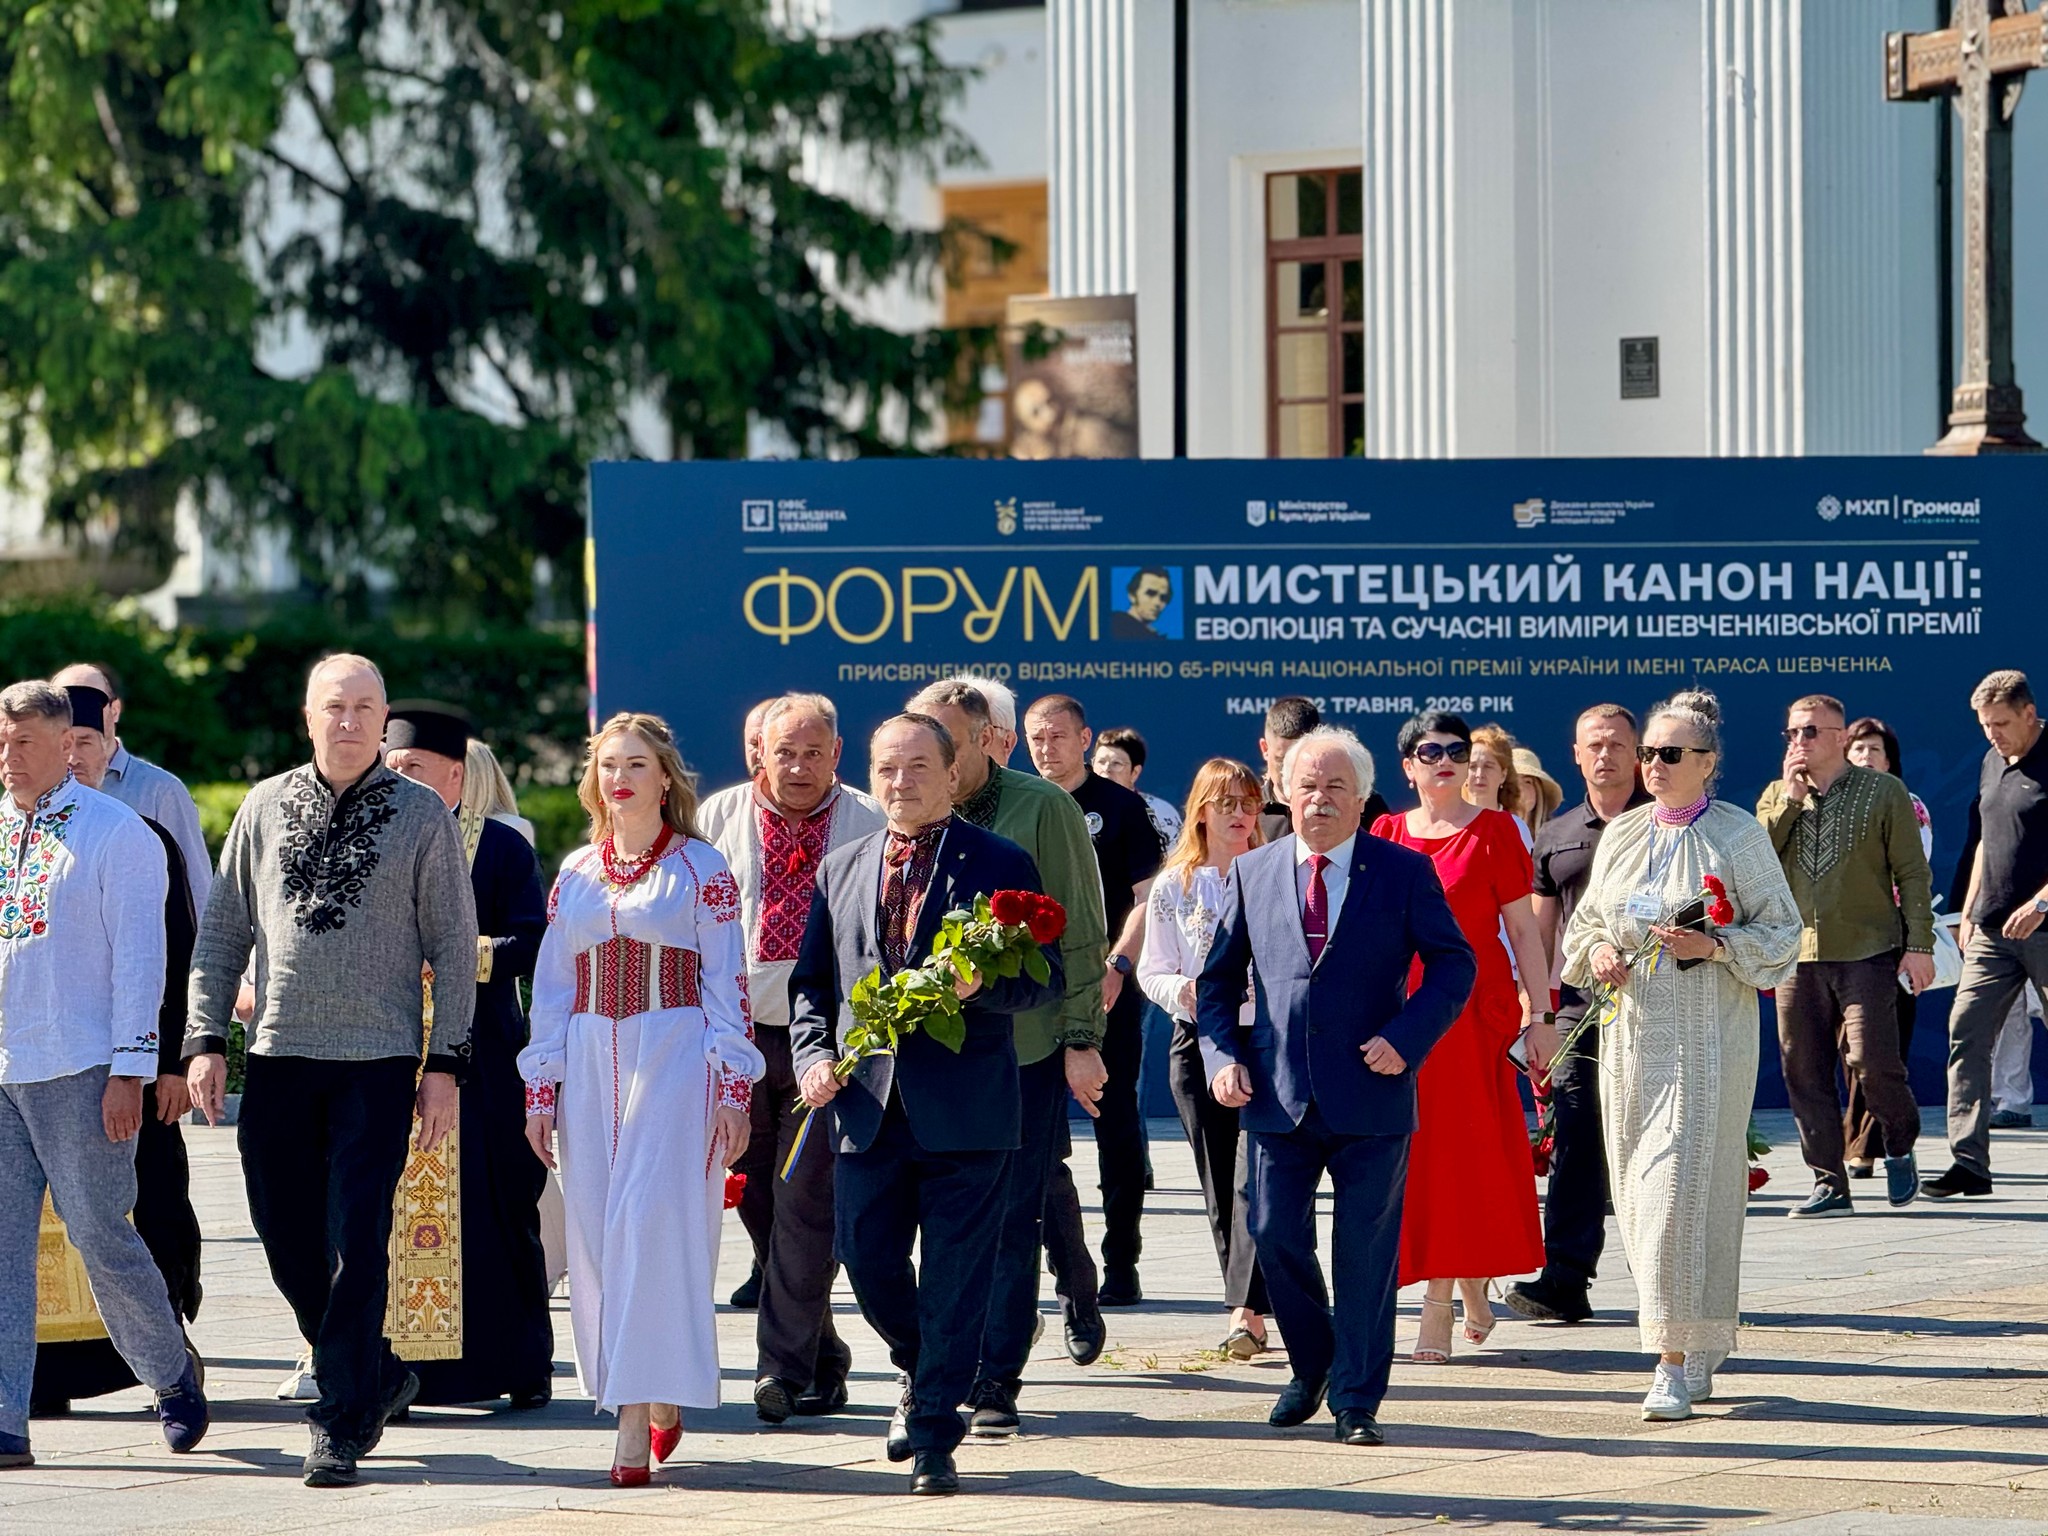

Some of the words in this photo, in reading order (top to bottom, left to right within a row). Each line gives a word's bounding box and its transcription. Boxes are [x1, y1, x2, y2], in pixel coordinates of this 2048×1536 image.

[1845, 499, 1890, 516] МХП
[1902, 498, 1981, 518] Громаді
[1194, 554, 1581, 611] МИСТЕЦЬКИЙ
[1603, 562, 1792, 602] КАНОН
[1815, 551, 1982, 606] НАЦІЇ:
[743, 567, 1099, 645] ФОРУМ
[1195, 616, 1344, 643] ЕВОЛЮЦІЯ
[1350, 617, 1386, 640] ТА
[1391, 616, 1511, 640] СУЧАСНІ
[1519, 615, 1628, 638] ВИМІРИ
[1636, 608, 1880, 637] ШЕВЧЕНКІВСЬКОЇ
[1887, 607, 1982, 635] ПРЕМІЇ
[838, 663, 1012, 681] ПРИСВЯЧЕНОГО
[1018, 662, 1173, 681] ВІДЗНАЧЕННЮ
[1179, 660, 1274, 679] 65-РІЧЧЯ
[1281, 657, 1443, 679] НАЦІОНАЛЬНОЇ
[1451, 656, 1522, 676] ПРЕМІЇ
[1529, 656, 1619, 676] УКРАЇНИ
[1627, 658, 1685, 675] ІМЕНІ
[1692, 658, 1770, 674] ТАРАСА
[1777, 657, 1892, 673] ШЕВЧЕНКА
[1331, 696, 1420, 715] ТРАВНЯ,
[1425, 696, 1474, 713] 2026
[1480, 696, 1514, 712] РІК
